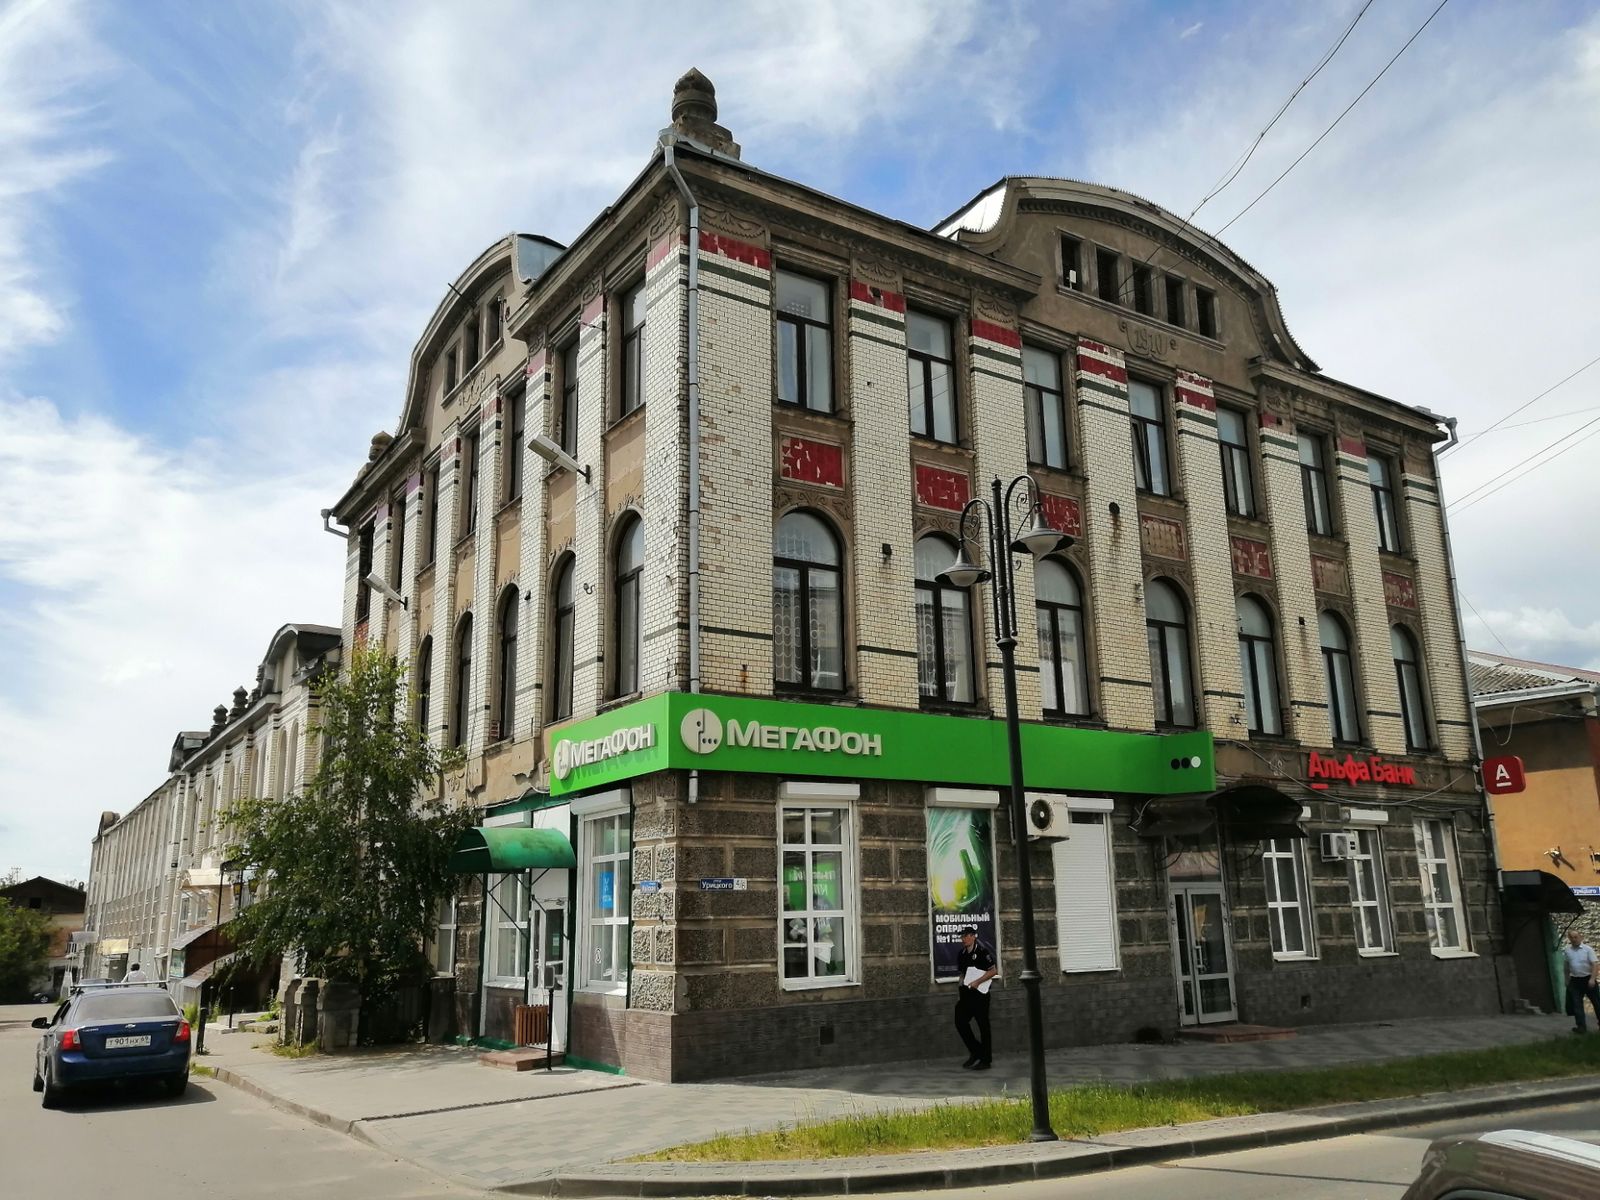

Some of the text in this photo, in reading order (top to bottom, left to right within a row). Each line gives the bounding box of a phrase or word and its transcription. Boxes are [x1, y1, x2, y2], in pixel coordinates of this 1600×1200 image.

[571, 723, 653, 769] МЕГАФОН
[726, 718, 883, 757] МЕГАФОН
[1308, 751, 1416, 787] Альфа Банк
[935, 912, 990, 923] МОБИЛЬНЫЙ
[935, 924, 978, 933] ОПЕРАТР
